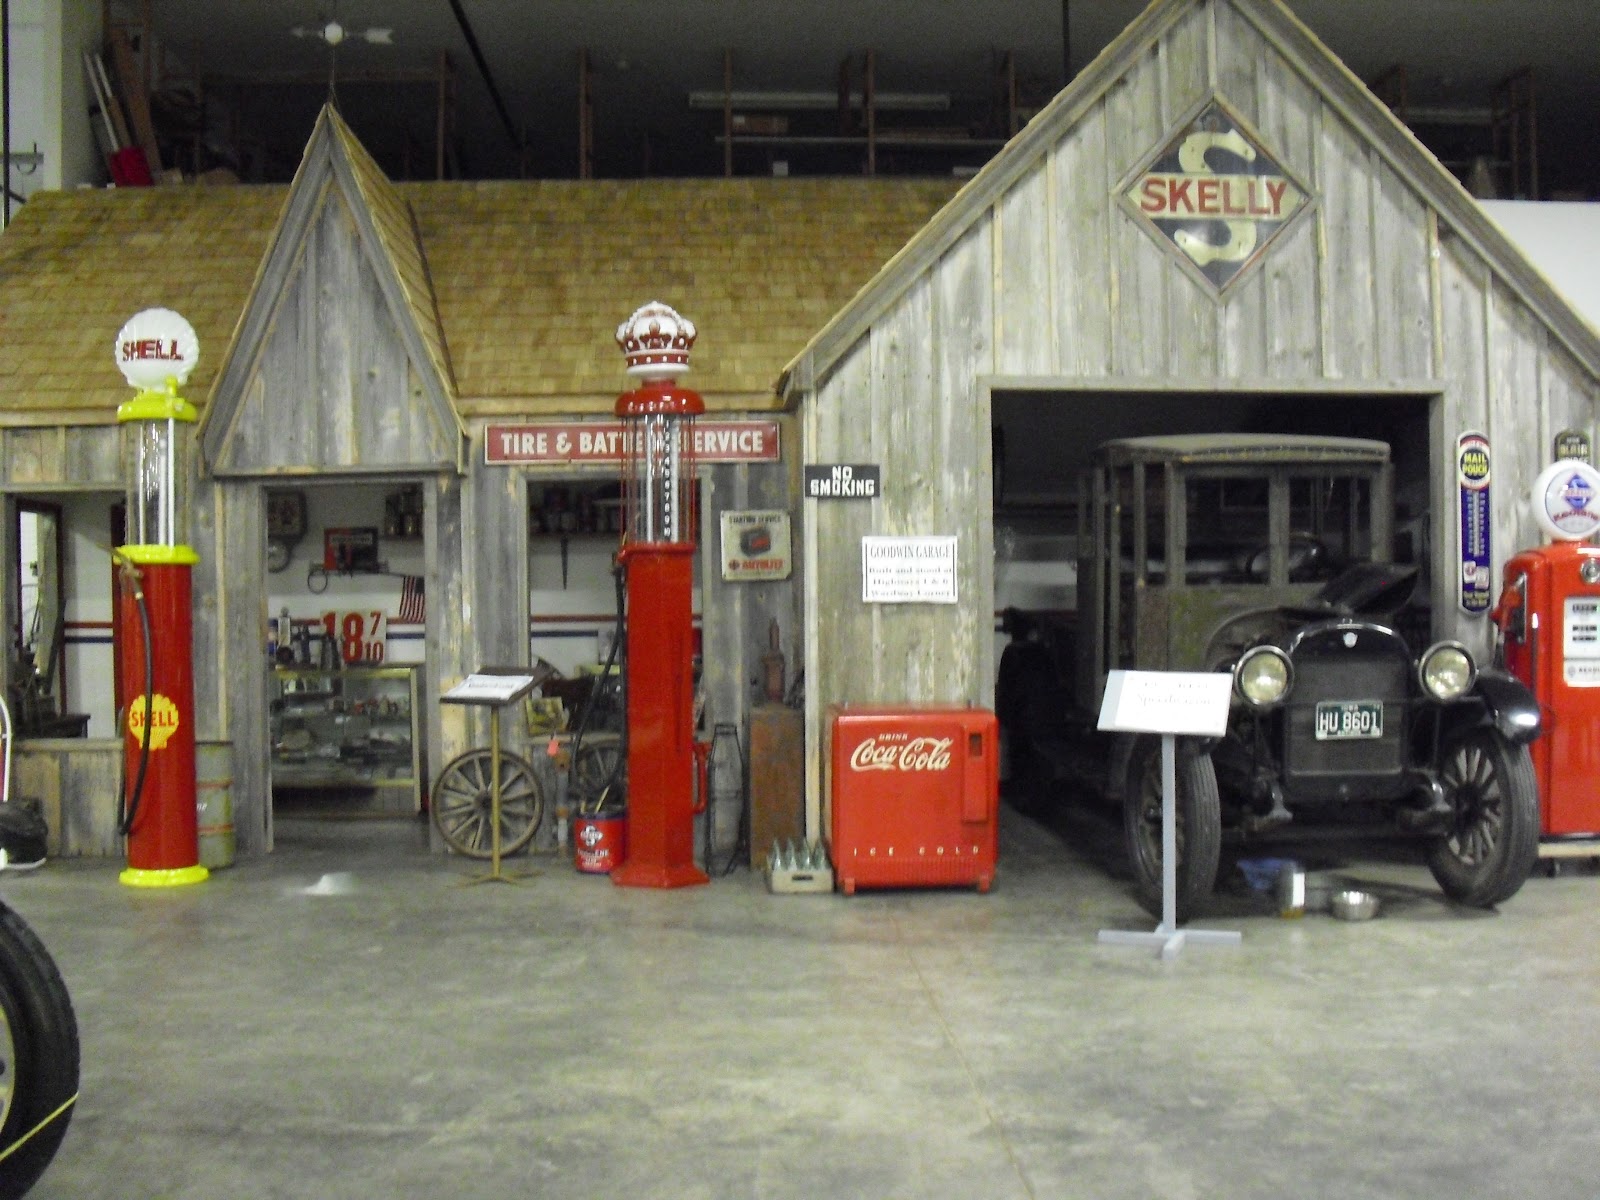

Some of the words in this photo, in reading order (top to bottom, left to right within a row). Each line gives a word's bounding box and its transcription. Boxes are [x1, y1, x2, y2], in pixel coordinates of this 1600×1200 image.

[1140, 178, 1287, 215] SKELLY
[122, 339, 184, 361] SHELL
[500, 432, 548, 455] TIRE
[556, 432, 572, 454] &
[579, 431, 673, 453] BATTE
[832, 466, 852, 481] NO
[810, 479, 875, 496] SMOKING
[870, 545, 914, 558] GOODWIN
[916, 545, 951, 558] GARAGE
[370, 611, 382, 637] 7
[131, 711, 176, 727] SHELL
[1320, 711, 1339, 733] HU
[1342, 710, 1377, 732] 8601
[878, 732, 908, 742] DRINK
[850, 736, 954, 773] Coca-Cola
[853, 847, 895, 857] ICE
[918, 845, 980, 857] COLD
